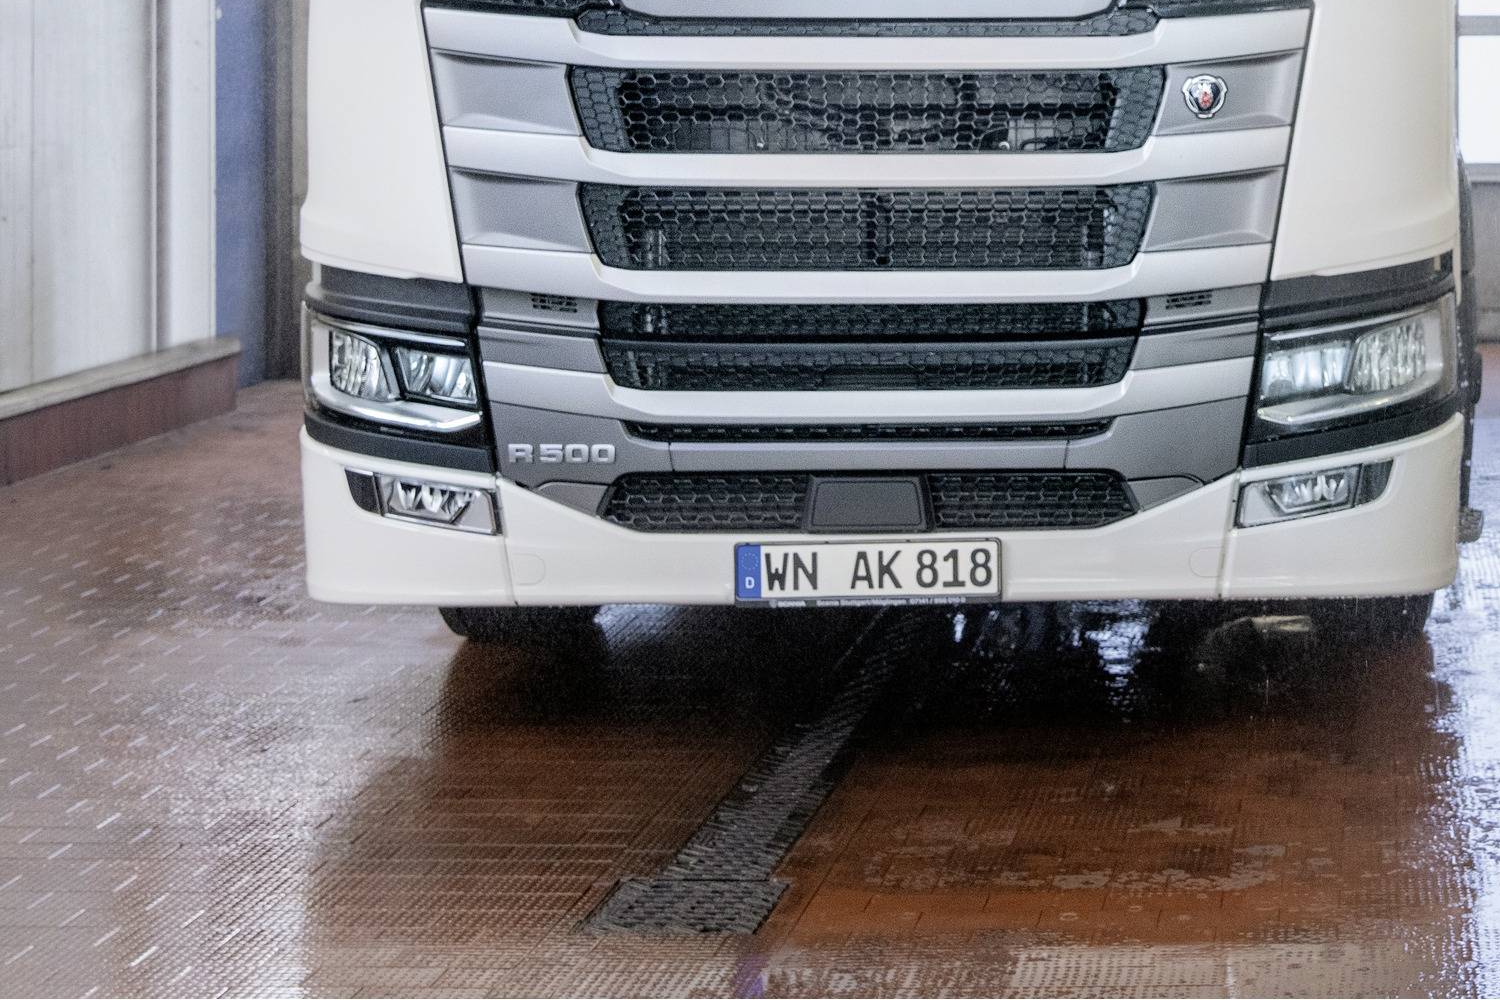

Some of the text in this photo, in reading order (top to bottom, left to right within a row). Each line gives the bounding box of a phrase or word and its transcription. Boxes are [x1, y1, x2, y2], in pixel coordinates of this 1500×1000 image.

[744, 576, 756, 590] D
[764, 548, 993, 592] WN AK 818
